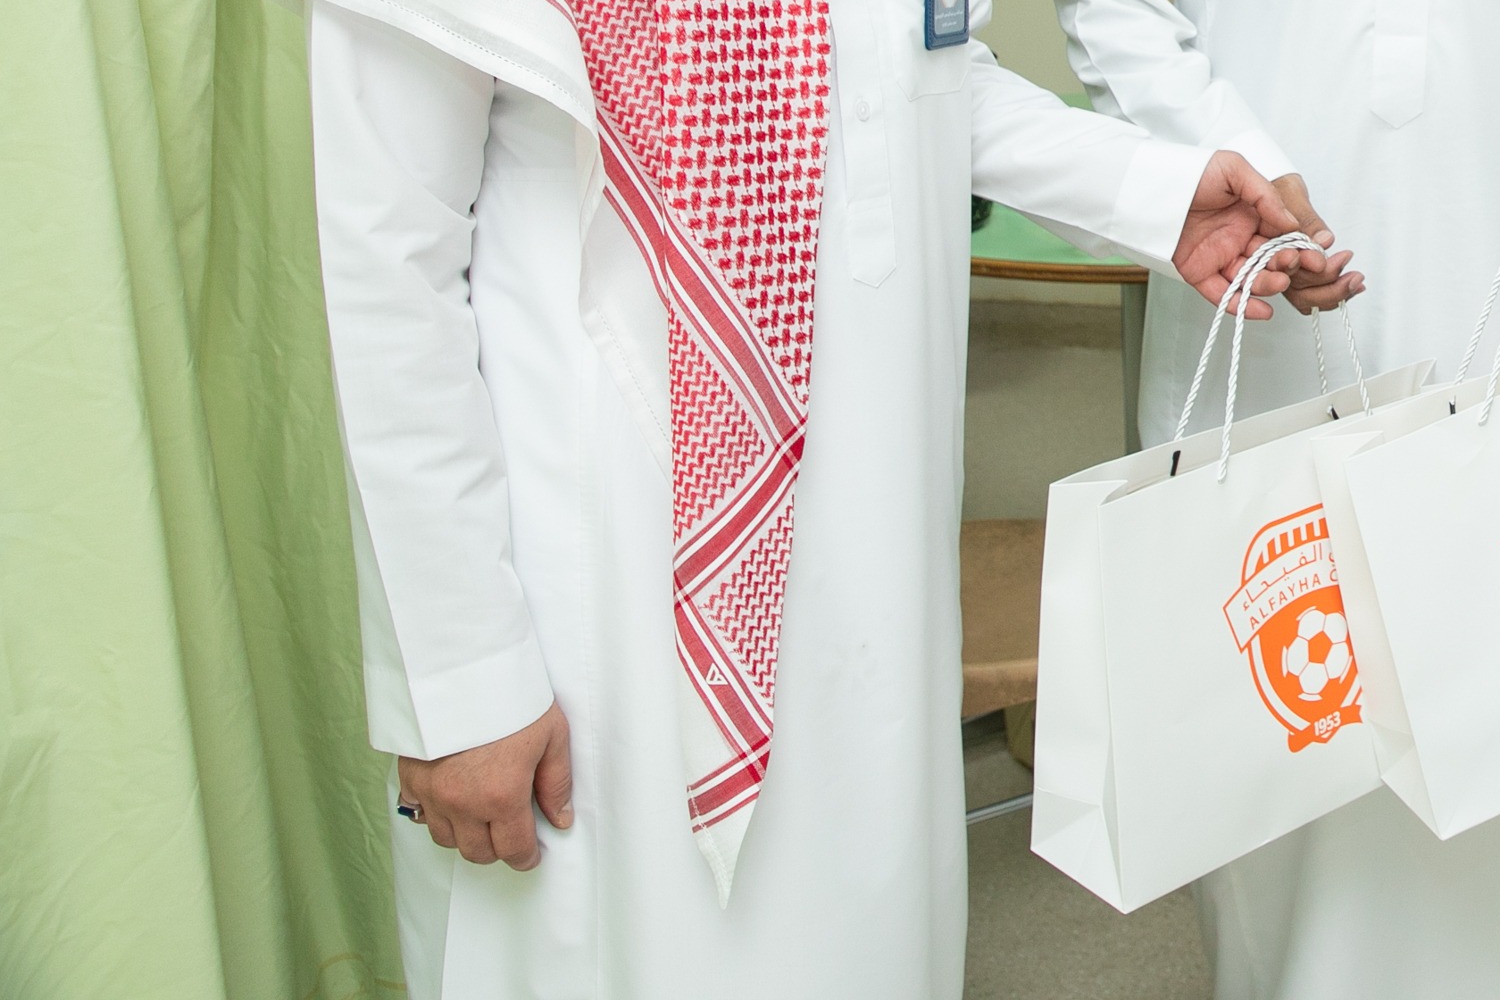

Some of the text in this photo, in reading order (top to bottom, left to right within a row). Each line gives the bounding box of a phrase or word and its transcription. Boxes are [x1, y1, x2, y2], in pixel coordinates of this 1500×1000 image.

[1242, 542, 1323, 611] الفيحاء
[1250, 573, 1321, 630] ALFAYHA
[1314, 711, 1342, 736] 1953
